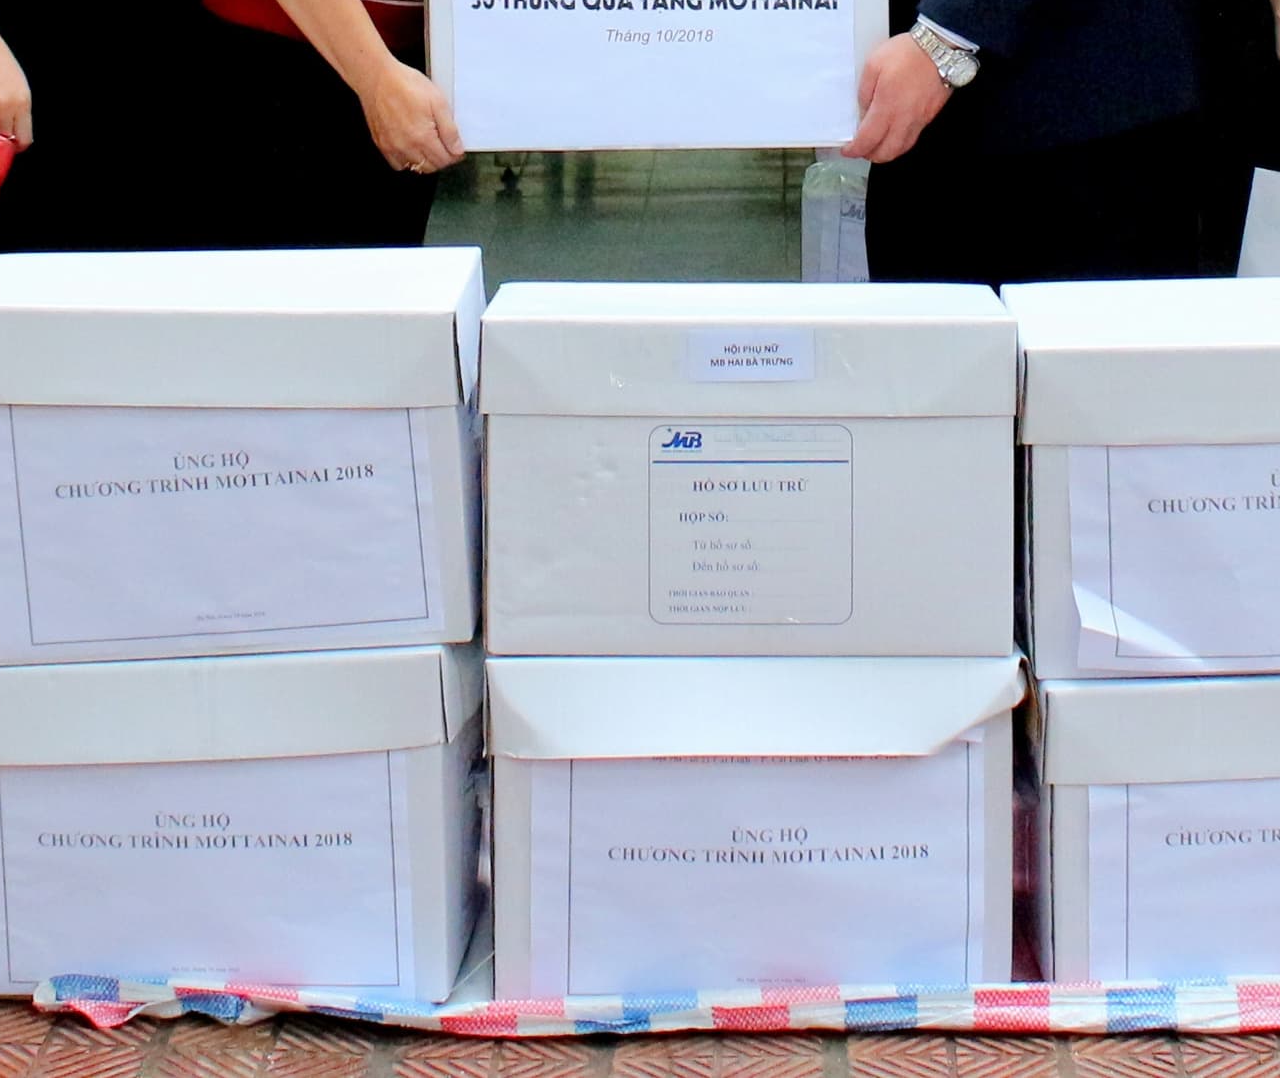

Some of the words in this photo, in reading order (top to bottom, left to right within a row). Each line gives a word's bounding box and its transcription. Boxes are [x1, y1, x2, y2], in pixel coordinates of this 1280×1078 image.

[606, 29, 650, 44] Tháng
[657, 29, 713, 43] 10/2018
[710, 358, 726, 367] MB
[728, 358, 744, 367] HAI
[746, 356, 759, 367] BÀ
[760, 358, 793, 366] TRƯNG
[222, 450, 250, 470] HỘ
[55, 480, 141, 499] CHƯƠNG
[146, 474, 208, 494] TRÌNH
[216, 467, 329, 490] MOTTAINAI
[336, 464, 374, 481] 2018
[1148, 496, 1236, 514] CHƯƠNG
[203, 812, 231, 831] HỘ
[38, 832, 122, 848] CHƯƠNG
[128, 833, 188, 848] TRÌNH
[196, 833, 309, 848] MOTTAINAI
[315, 833, 353, 847] 2018
[780, 826, 808, 845] HỘ
[1165, 828, 1252, 847] CHƯƠNG
[608, 846, 696, 863] CHƯƠNG
[702, 846, 765, 863] TRÌNH
[773, 844, 885, 863] MOTTAINAI
[892, 844, 929, 860] 2018
